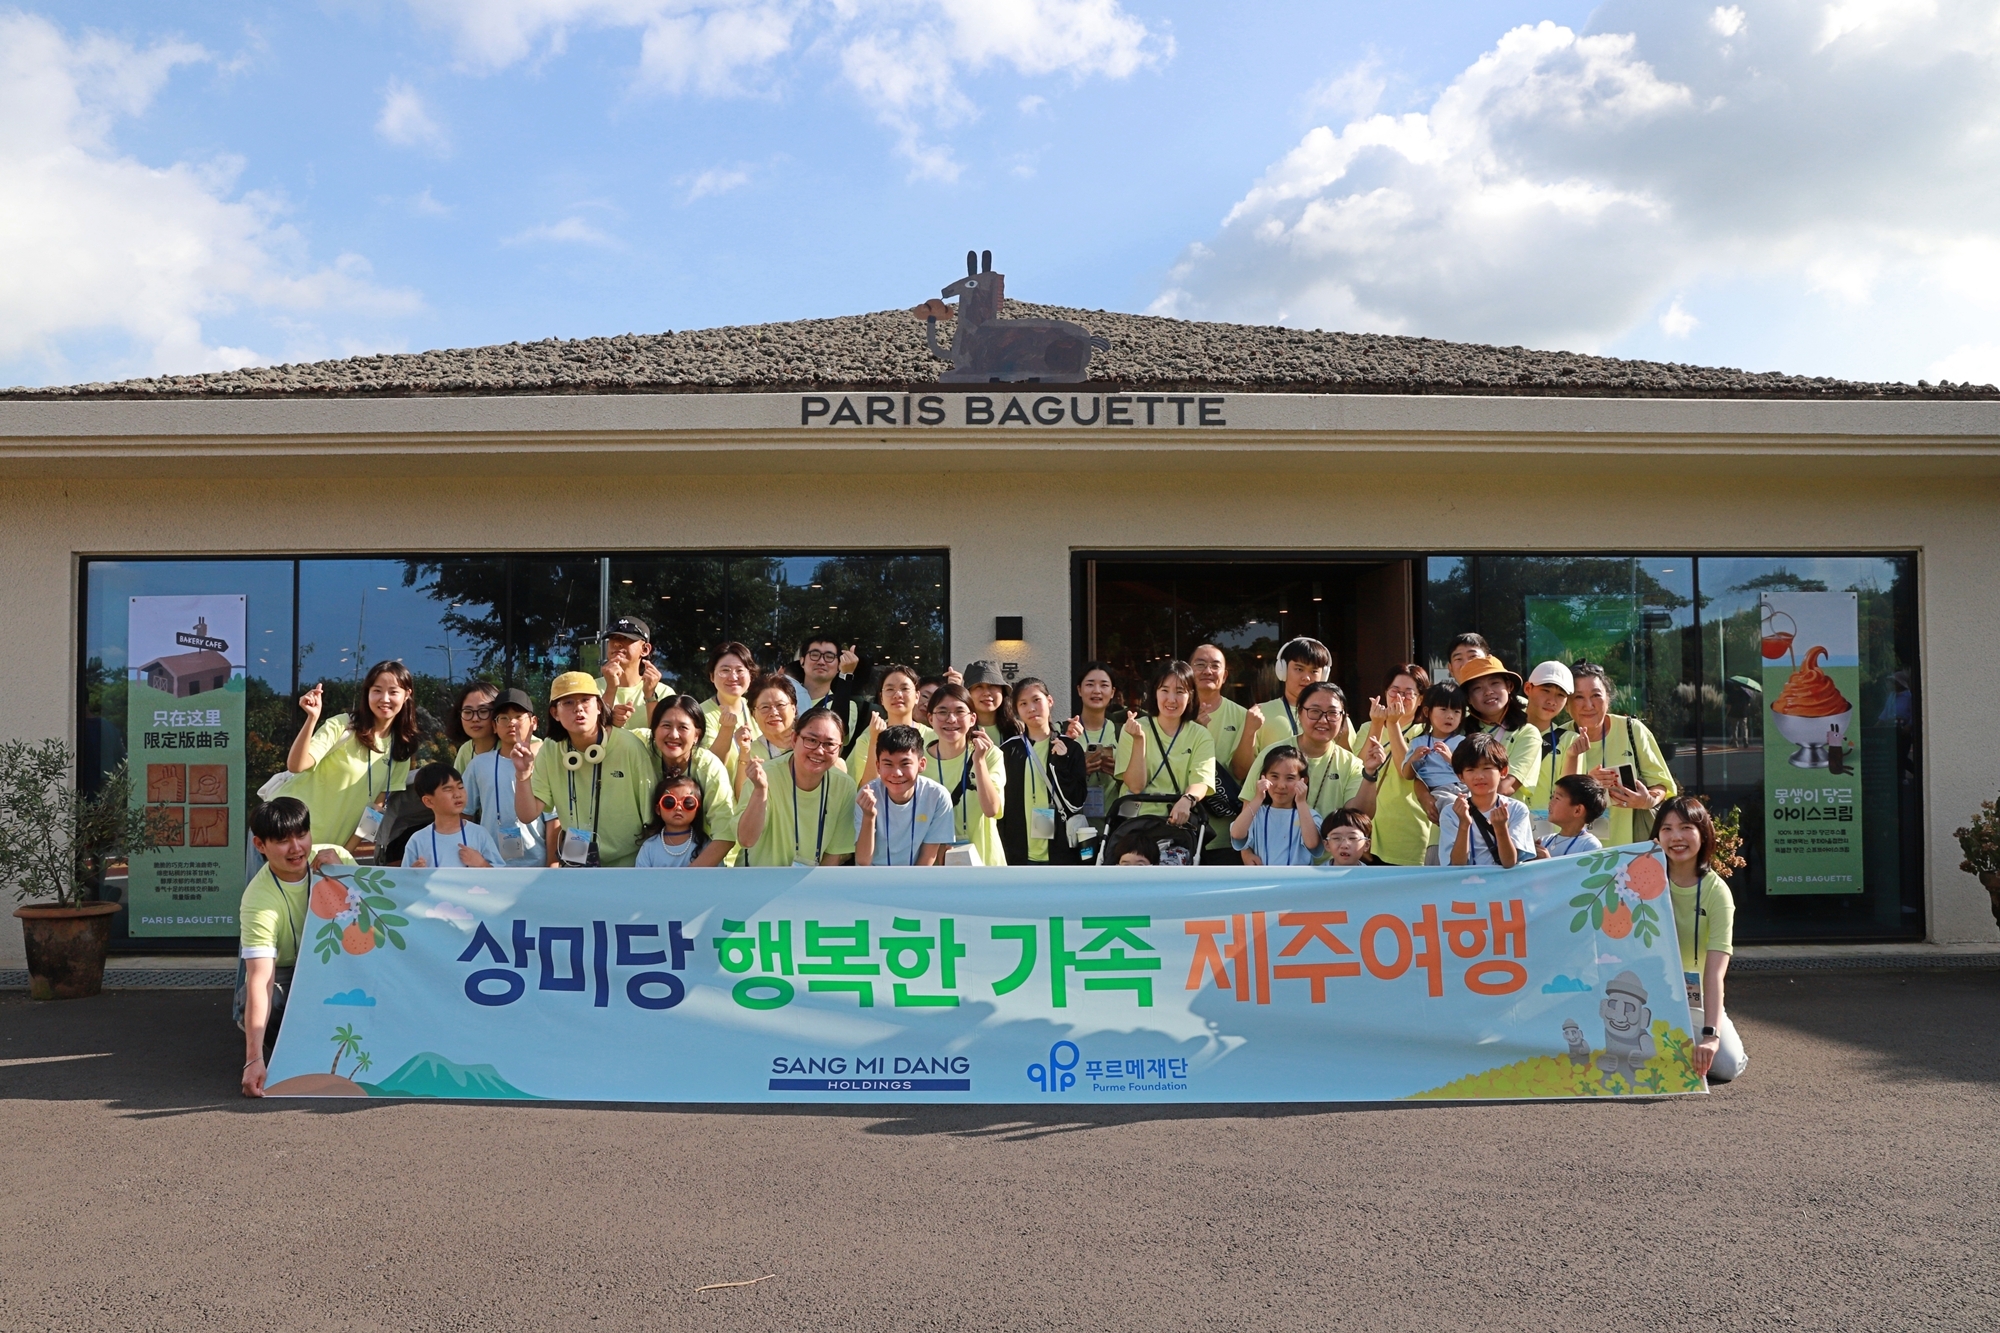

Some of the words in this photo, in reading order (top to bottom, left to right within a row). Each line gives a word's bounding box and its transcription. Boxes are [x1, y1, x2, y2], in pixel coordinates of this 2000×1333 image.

[801, 396, 946, 426] PARIS
[965, 396, 1227, 426] BAGUETTE
[179, 635, 204, 646] BAKERY
[205, 640, 222, 650] CAFE
[1002, 662, 1019, 686] 몽
[153, 709, 221, 727] 只在这里
[144, 731, 230, 749] 限定版曲奇
[1774, 788, 1818, 805] 몽생이
[1822, 788, 1853, 804] 당근
[1773, 806, 1853, 821] 아이스크림
[141, 916, 174, 924] PARIS
[176, 916, 234, 924] BAGUETTE
[456, 919, 695, 1011] 상미당
[712, 916, 966, 1011] 행복한
[990, 915, 1161, 1008] 가족
[1184, 899, 1528, 1005] 제주여행
[771, 1056, 847, 1075] SANG
[855, 1056, 884, 1074] MI
[893, 1056, 970, 1075] DANG
[1085, 1057, 1189, 1081] 푸르메재단
[827, 1080, 912, 1090] HOLDINGS
[1093, 1083, 1126, 1092] Purme
[1128, 1082, 1188, 1091] Foundation
